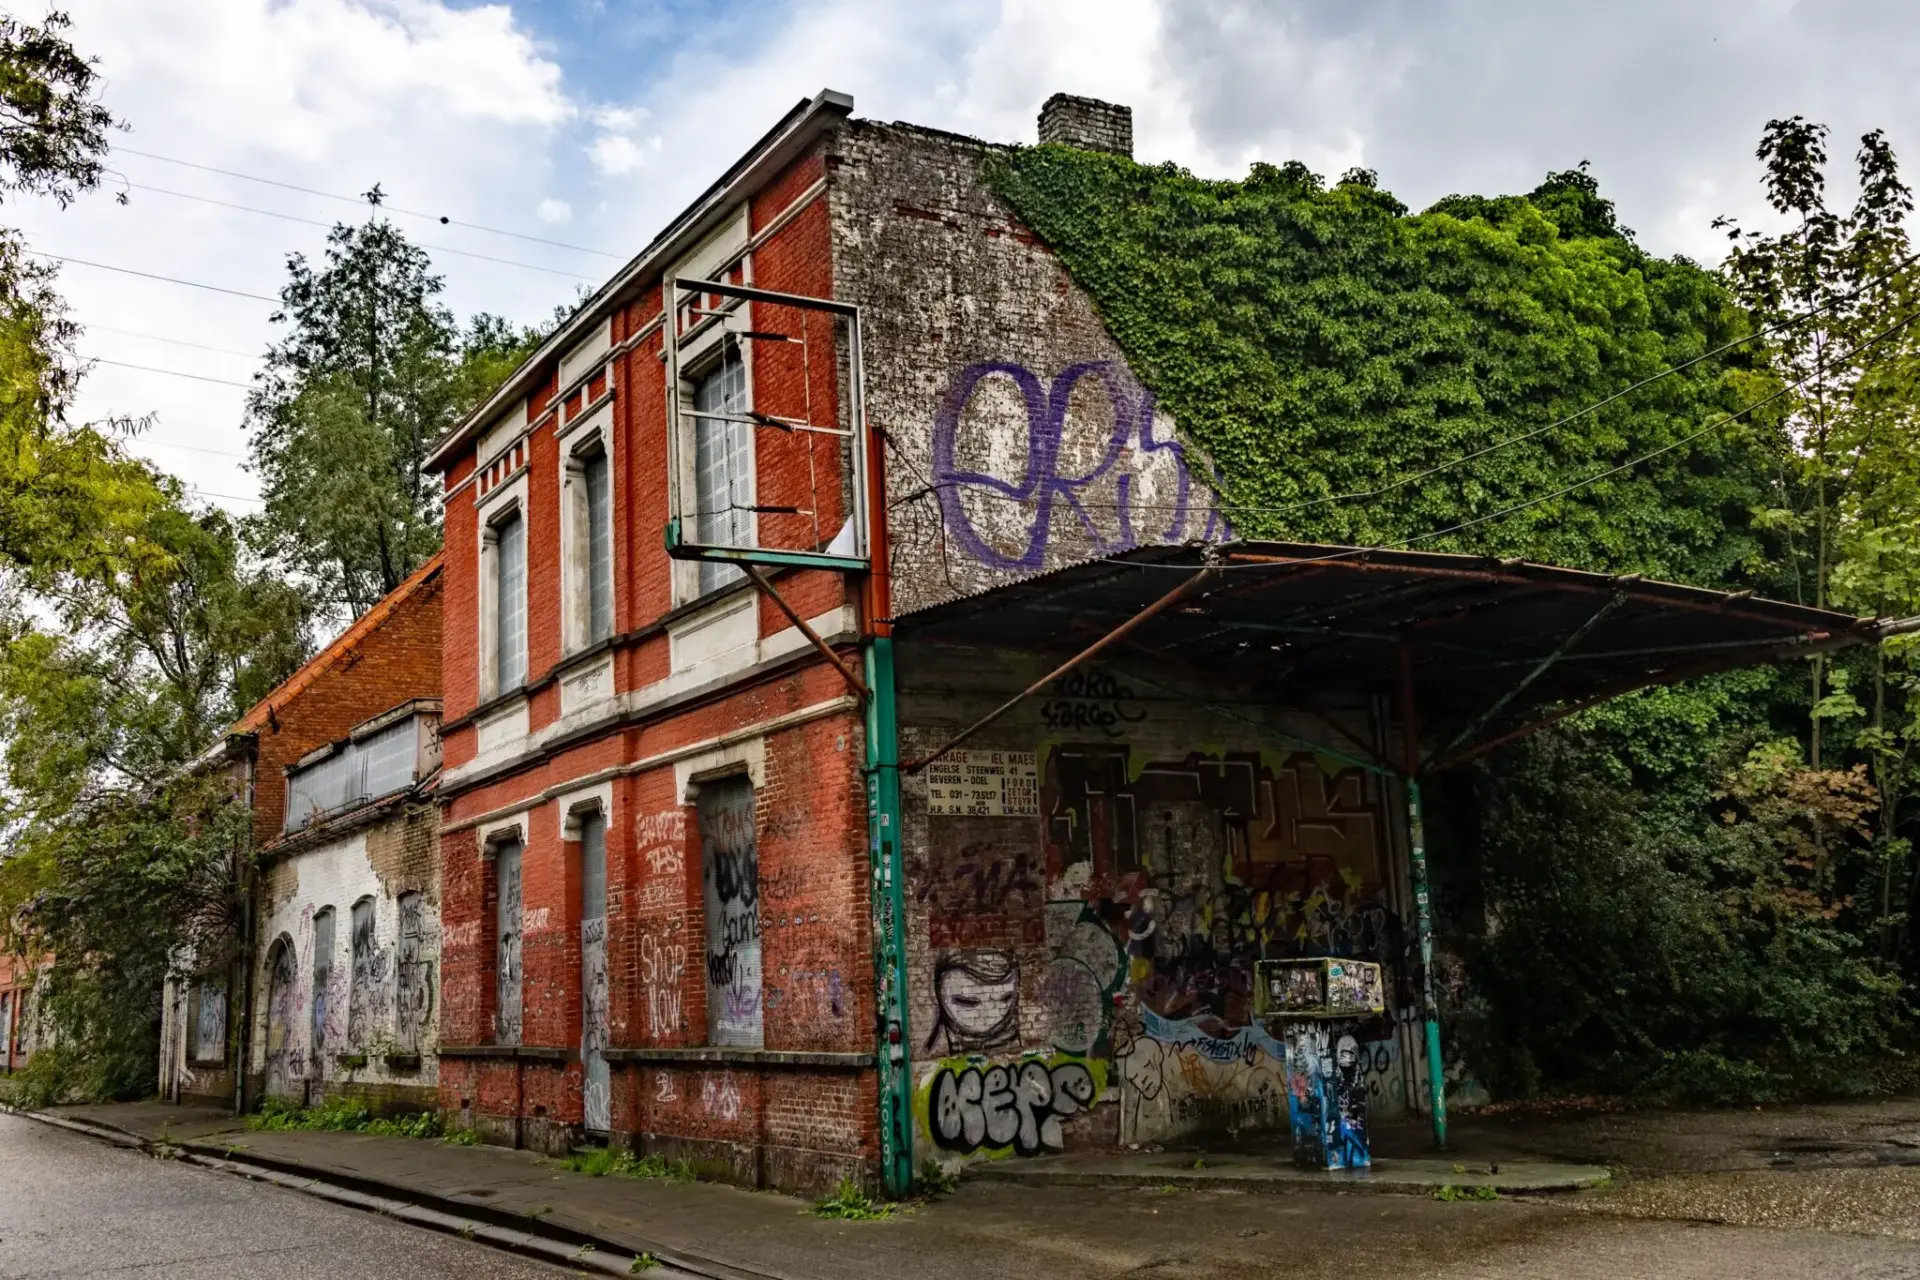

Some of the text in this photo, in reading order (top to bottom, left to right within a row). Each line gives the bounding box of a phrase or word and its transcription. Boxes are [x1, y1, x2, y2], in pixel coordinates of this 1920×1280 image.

[1008, 753, 1035, 765] MAES
[929, 764, 1018, 775] ENGELSE STEENWEG 41
[930, 775, 961, 784] BEVEREN
[970, 776, 988, 785] DOEL
[1006, 778, 1032, 787] FORD
[930, 789, 946, 799] TEL.
[949, 790, 962, 799] 031
[1006, 787, 1032, 797] ZETOR
[1006, 796, 1032, 806] STEYR
